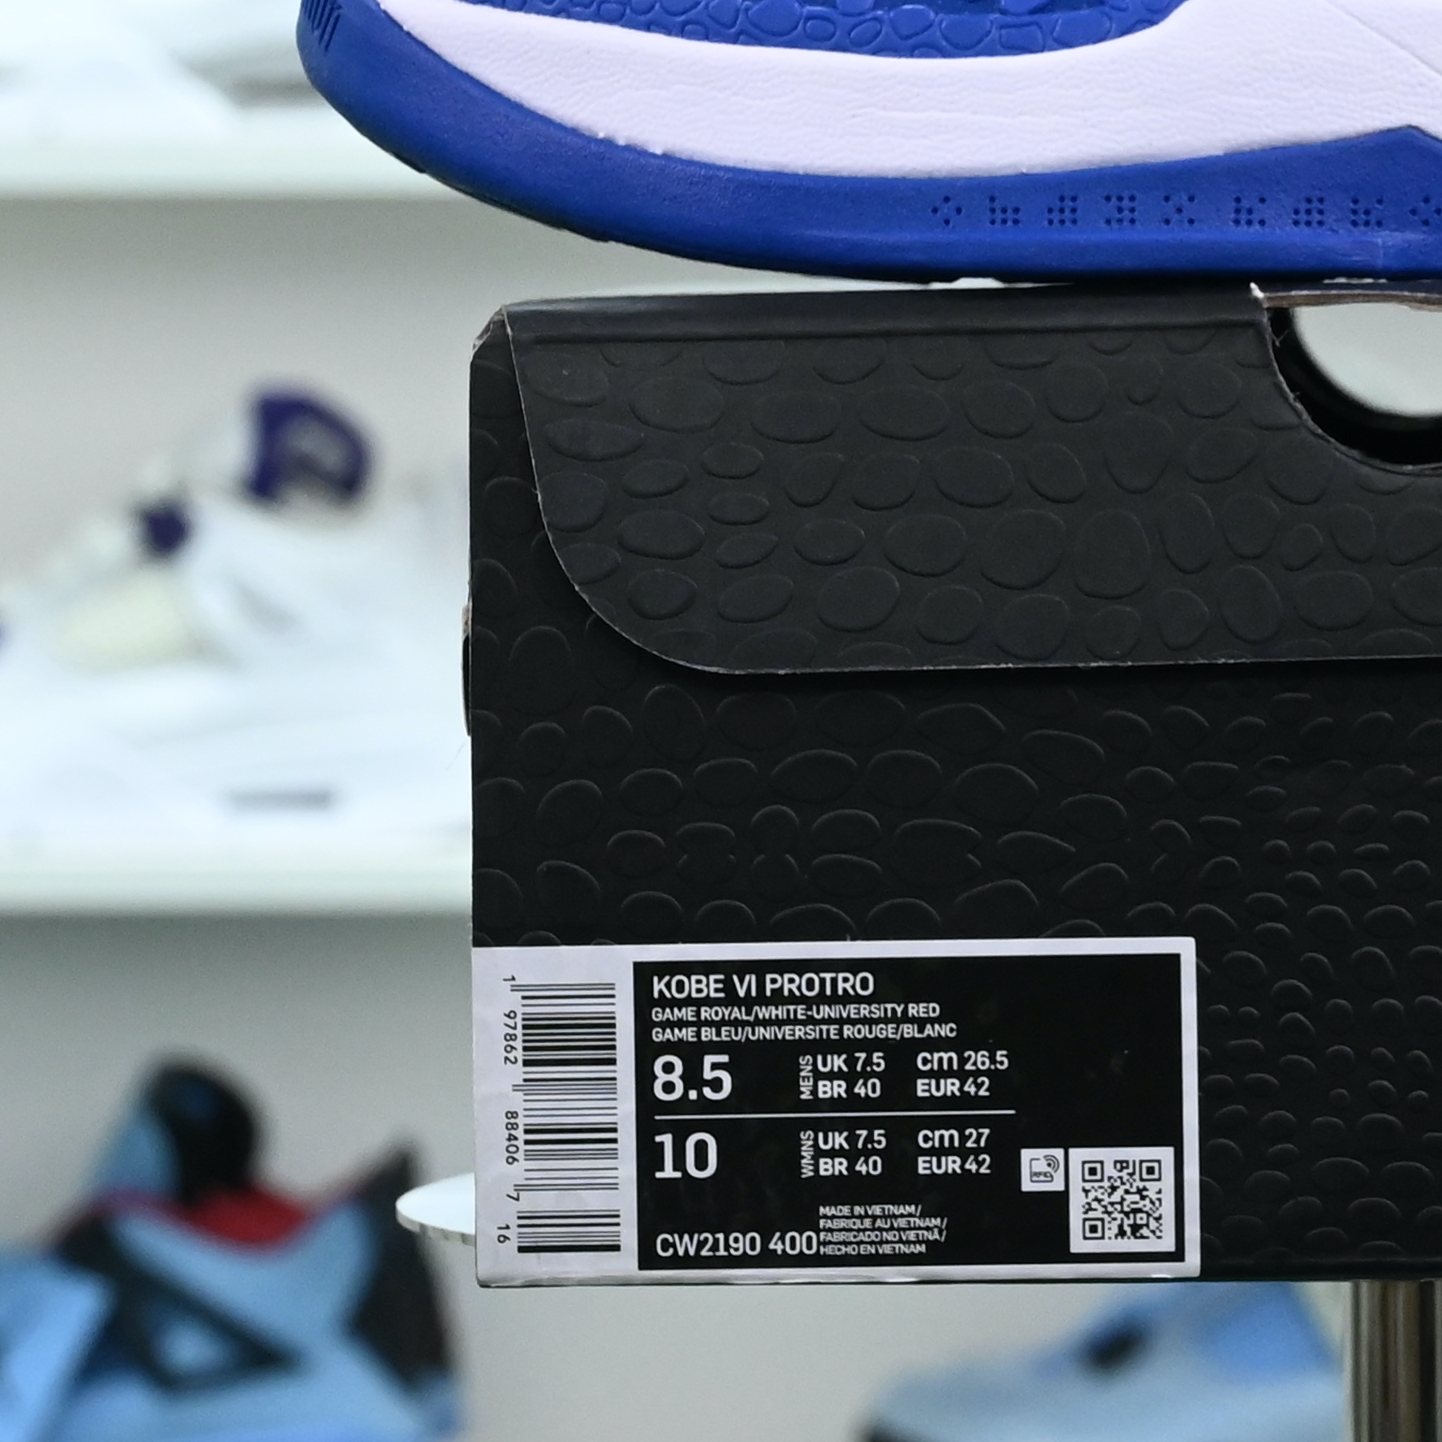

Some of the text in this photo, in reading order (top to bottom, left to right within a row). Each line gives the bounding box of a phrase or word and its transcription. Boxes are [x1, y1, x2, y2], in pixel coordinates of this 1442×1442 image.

[653, 971, 875, 999] KOBE VI PROTRO
[651, 1003, 941, 1022] GAME ROYAL/WHITE-UNIVERSITY RED
[651, 1023, 958, 1043] GAME BLEU/UNIVERSITE ROUGE/BLANC
[816, 1051, 886, 1073] UK 7.5
[916, 1050, 1009, 1071] cm 26.5
[653, 1054, 733, 1101] 8.5
[799, 1054, 814, 1100] MENS
[916, 1076, 990, 1097] EUR 42
[502, 974, 520, 1202] 1 97862 88406 7
[817, 1078, 881, 1099] BR 40
[817, 1129, 887, 1150] UK 7.5
[917, 1128, 991, 1149] cm 27
[654, 1132, 718, 1179] 10
[800, 1130, 815, 1178] WMNS
[917, 1153, 991, 1175] EUR 42
[818, 1155, 882, 1176] BR 40
[819, 1205, 852, 1216] MADE
[853, 1205, 865, 1215] IN
[496, 1223, 511, 1244] 16
[819, 1218, 873, 1229] FABRIQUE
[874, 1218, 891, 1228] AU
[656, 1230, 818, 1257] CW2190 400
[819, 1231, 881, 1243] FABRICADO
[882, 1231, 899, 1241] NO
[820, 1243, 927, 1255] HECHO EN VIETNAM
